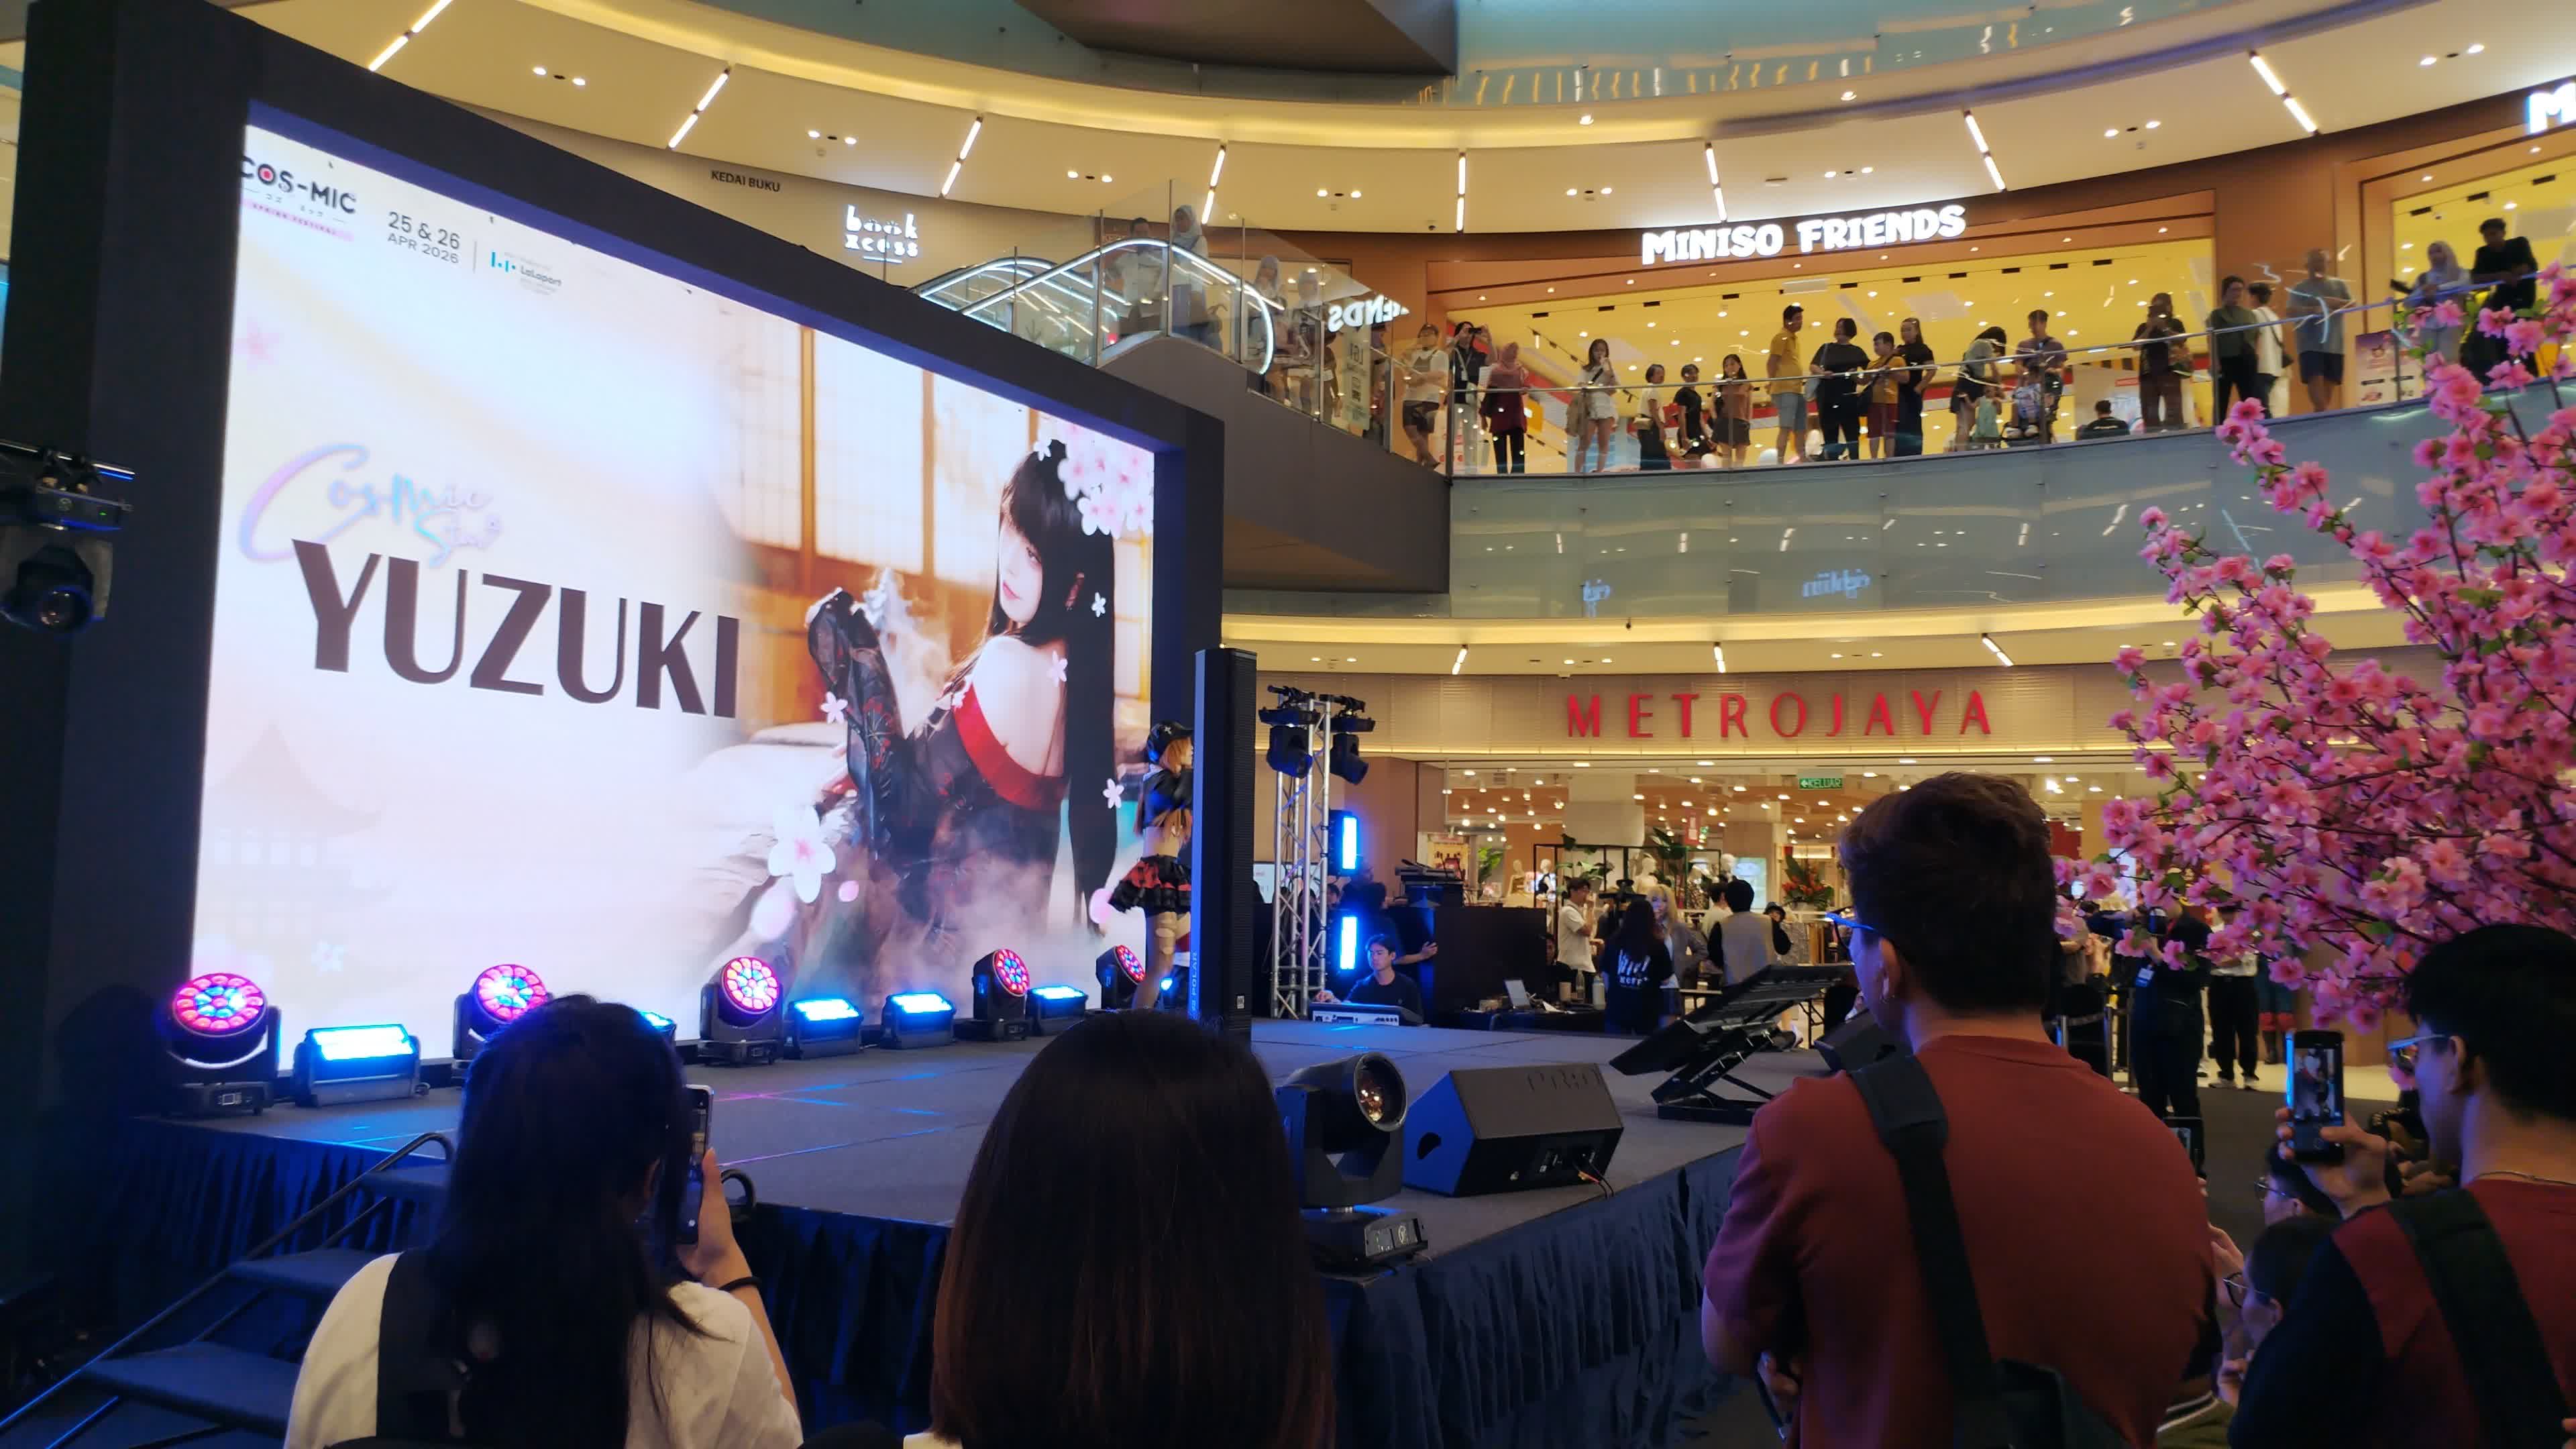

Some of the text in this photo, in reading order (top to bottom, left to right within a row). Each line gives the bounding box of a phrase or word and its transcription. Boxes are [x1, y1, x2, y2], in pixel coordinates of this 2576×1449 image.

[710, 170, 781, 193] KEDAI BUKU
[388, 211, 462, 250] 25 & 26
[845, 204, 918, 240] book
[1642, 204, 1968, 265] MINISO FRIENDS
[387, 233, 460, 264] APR 2026
[291, 539, 740, 718] YUZUKI
[1567, 688, 1992, 739] METROJAYA
[1809, 778, 1841, 788] KELUAR
